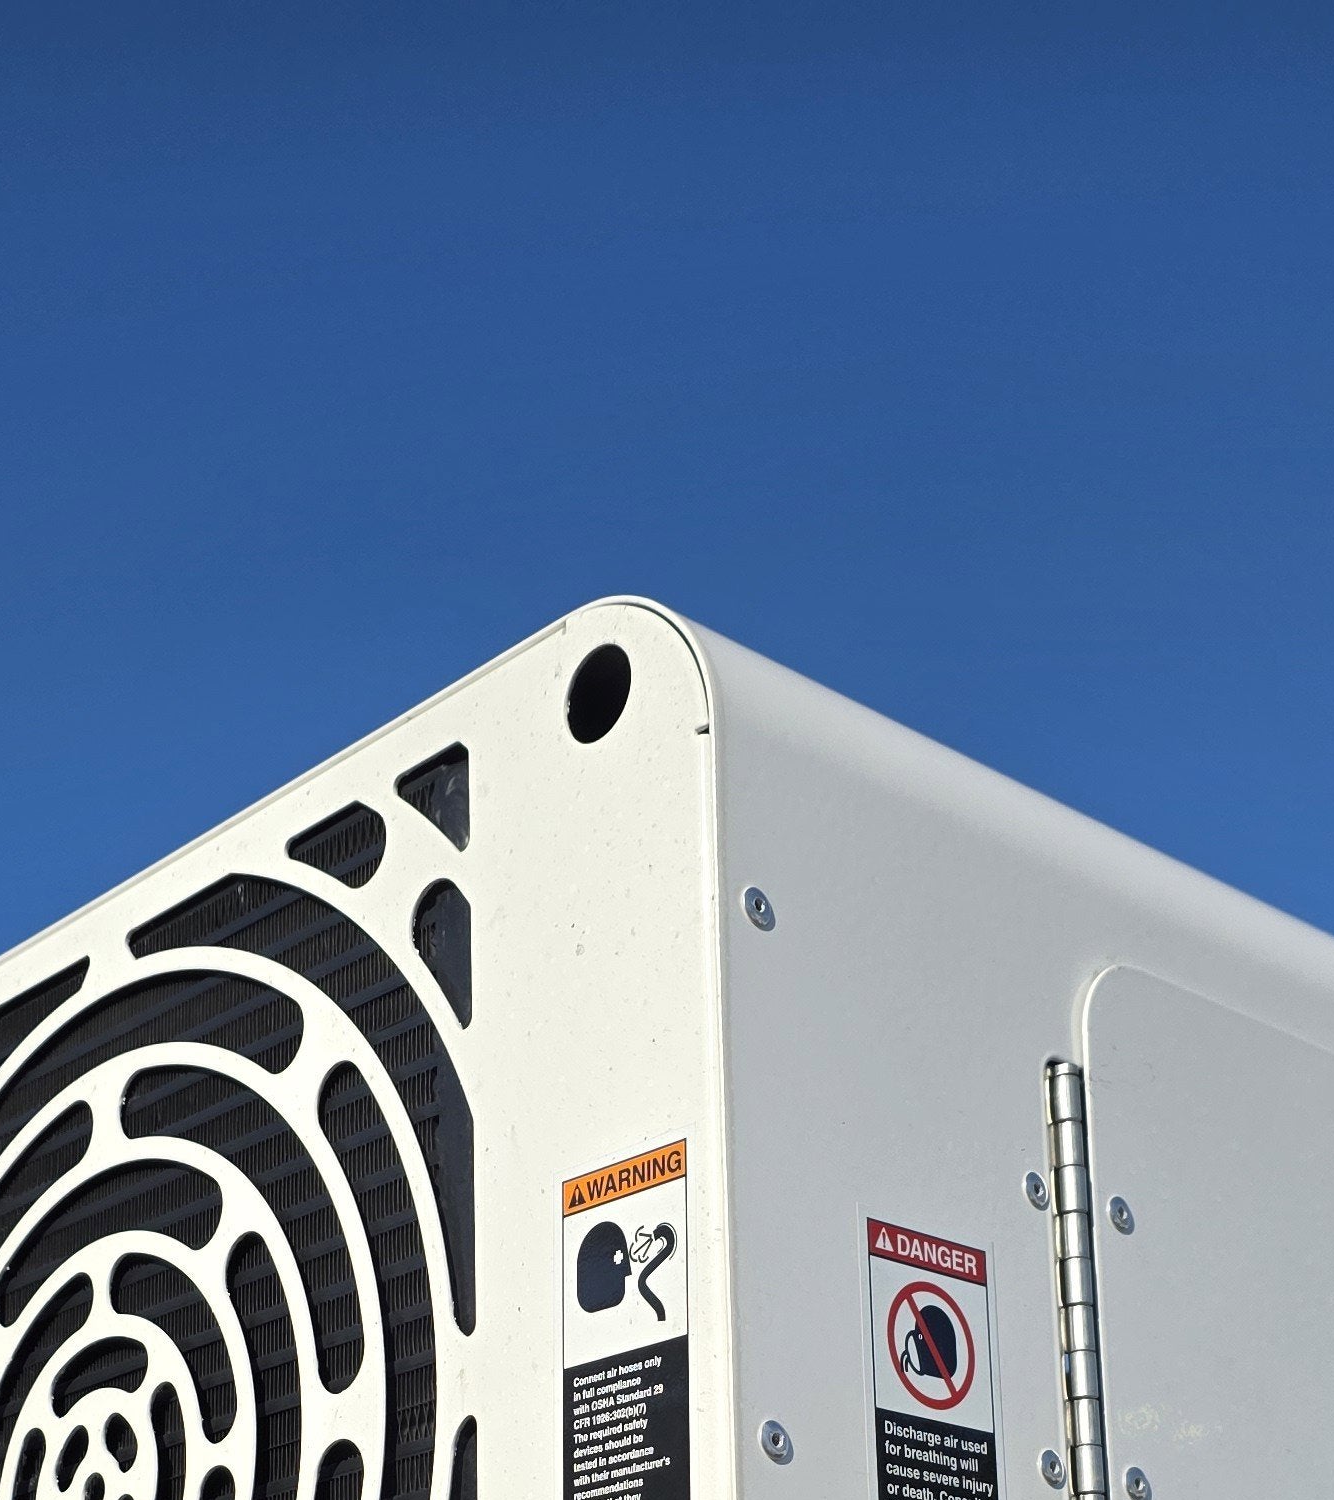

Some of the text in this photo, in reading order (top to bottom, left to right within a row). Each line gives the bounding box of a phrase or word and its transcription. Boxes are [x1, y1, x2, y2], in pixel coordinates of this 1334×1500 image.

[587, 1150, 682, 1201] WARNING
[896, 1233, 978, 1276] DANGER
[590, 1396, 615, 1411] OSHA
[884, 1419, 987, 1454] Discharge air used
[884, 1439, 978, 1472] for breathing will
[885, 1462, 993, 1497] cause severe injury
[886, 1483, 899, 1495] or
